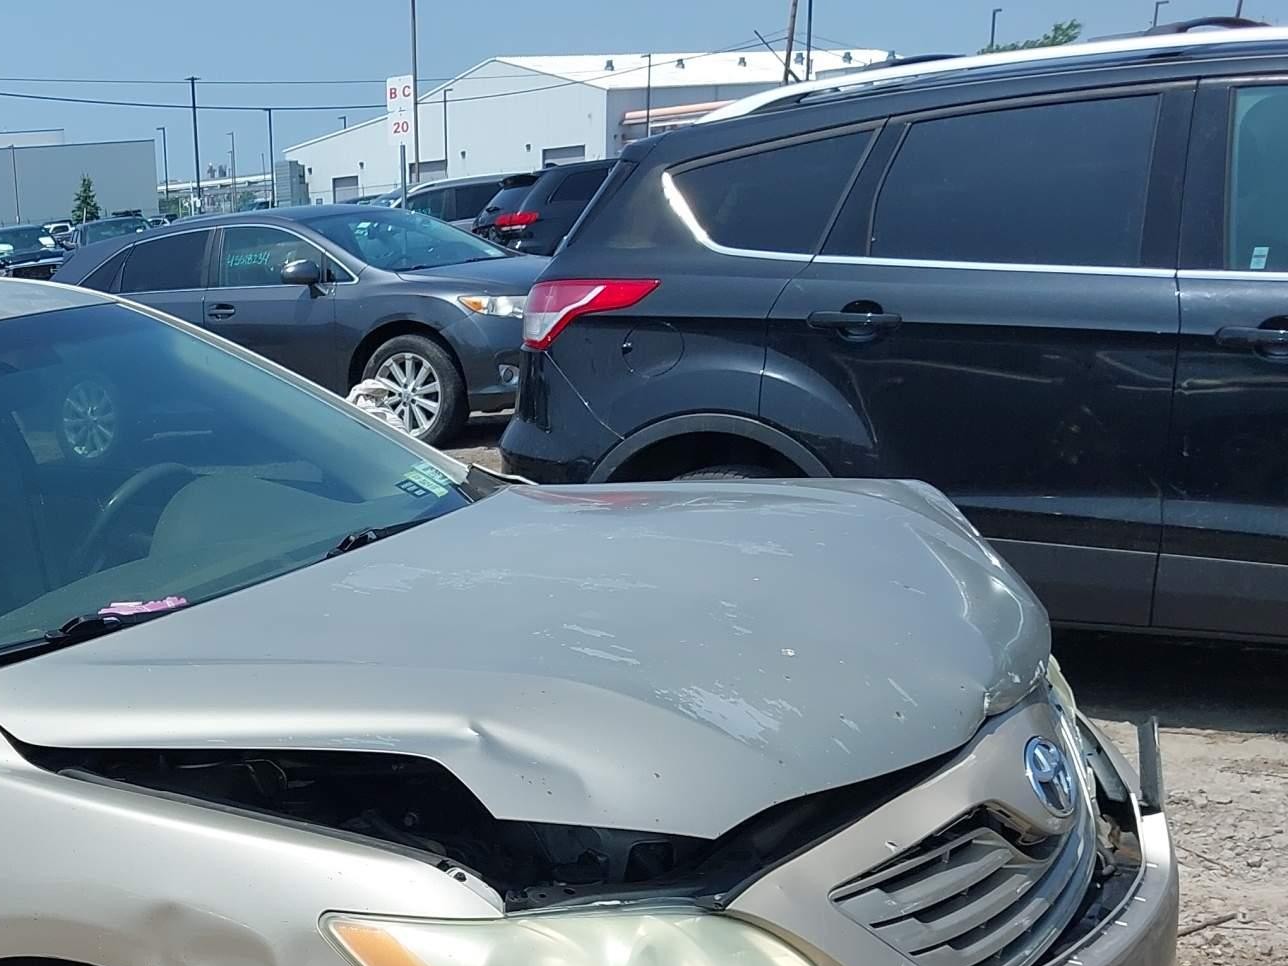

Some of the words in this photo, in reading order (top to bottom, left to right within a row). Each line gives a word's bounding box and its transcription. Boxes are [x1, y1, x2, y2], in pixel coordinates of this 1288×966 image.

[389, 87, 398, 100] B
[402, 85, 411, 98] C
[393, 121, 409, 134] 20
